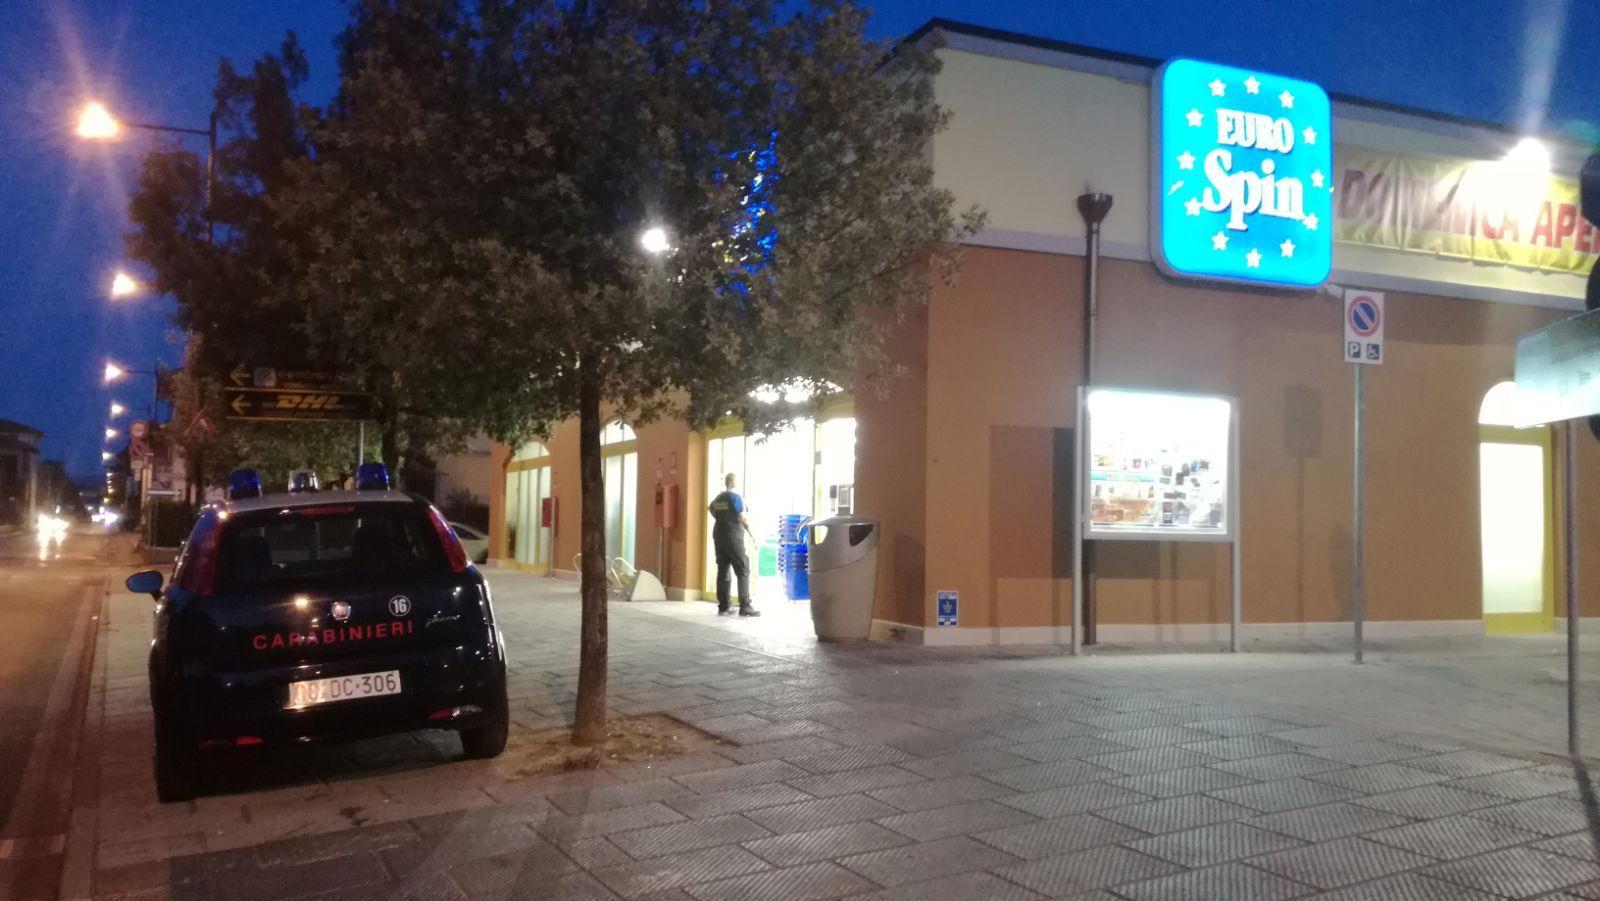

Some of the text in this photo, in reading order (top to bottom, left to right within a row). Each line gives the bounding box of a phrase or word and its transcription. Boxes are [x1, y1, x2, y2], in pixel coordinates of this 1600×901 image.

[1216, 109, 1295, 154] EURO
[1201, 148, 1306, 231] Spin
[276, 394, 344, 410] DHL
[392, 598, 409, 614] 16
[252, 621, 413, 650] CARABINIERI
